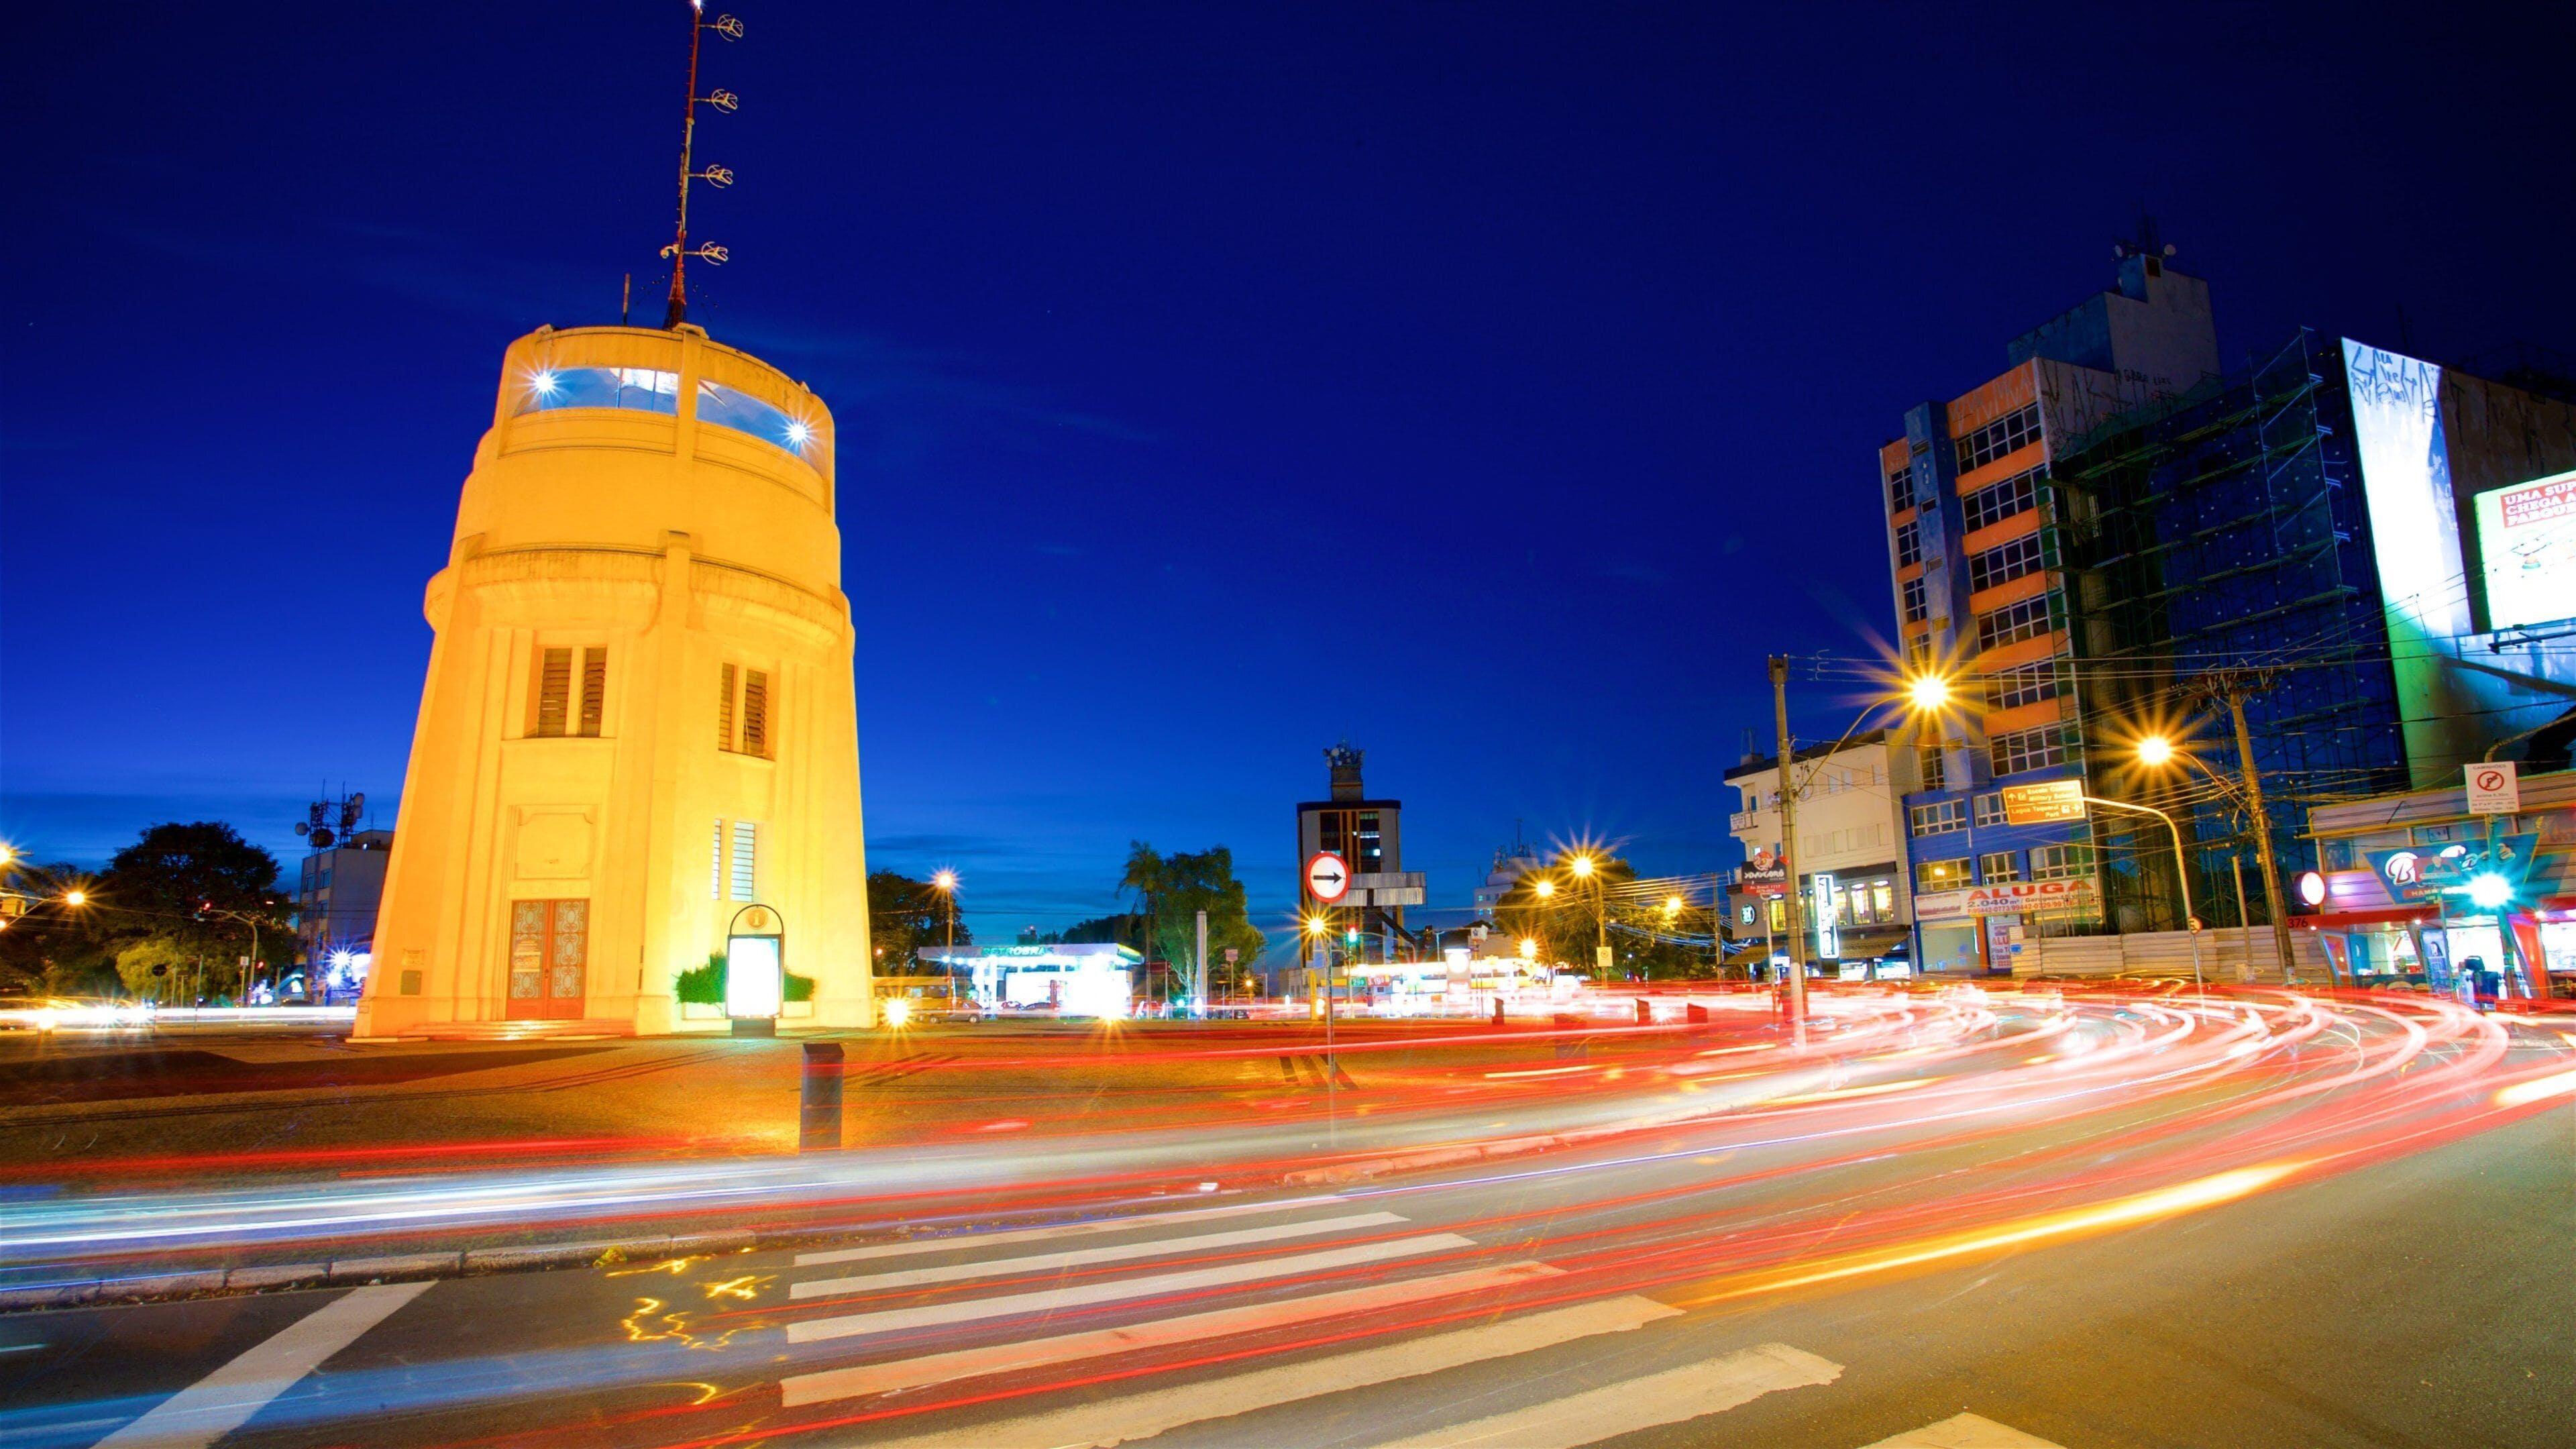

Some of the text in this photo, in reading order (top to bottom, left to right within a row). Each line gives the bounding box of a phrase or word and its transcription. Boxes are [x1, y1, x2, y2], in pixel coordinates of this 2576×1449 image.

[2505, 490, 2542, 505] UMA
[2506, 496, 2563, 515] CHEGA
[1968, 879, 2093, 901] ALUGA
[1968, 898, 2008, 908] 2.040
[2288, 917, 2308, 928] 376
